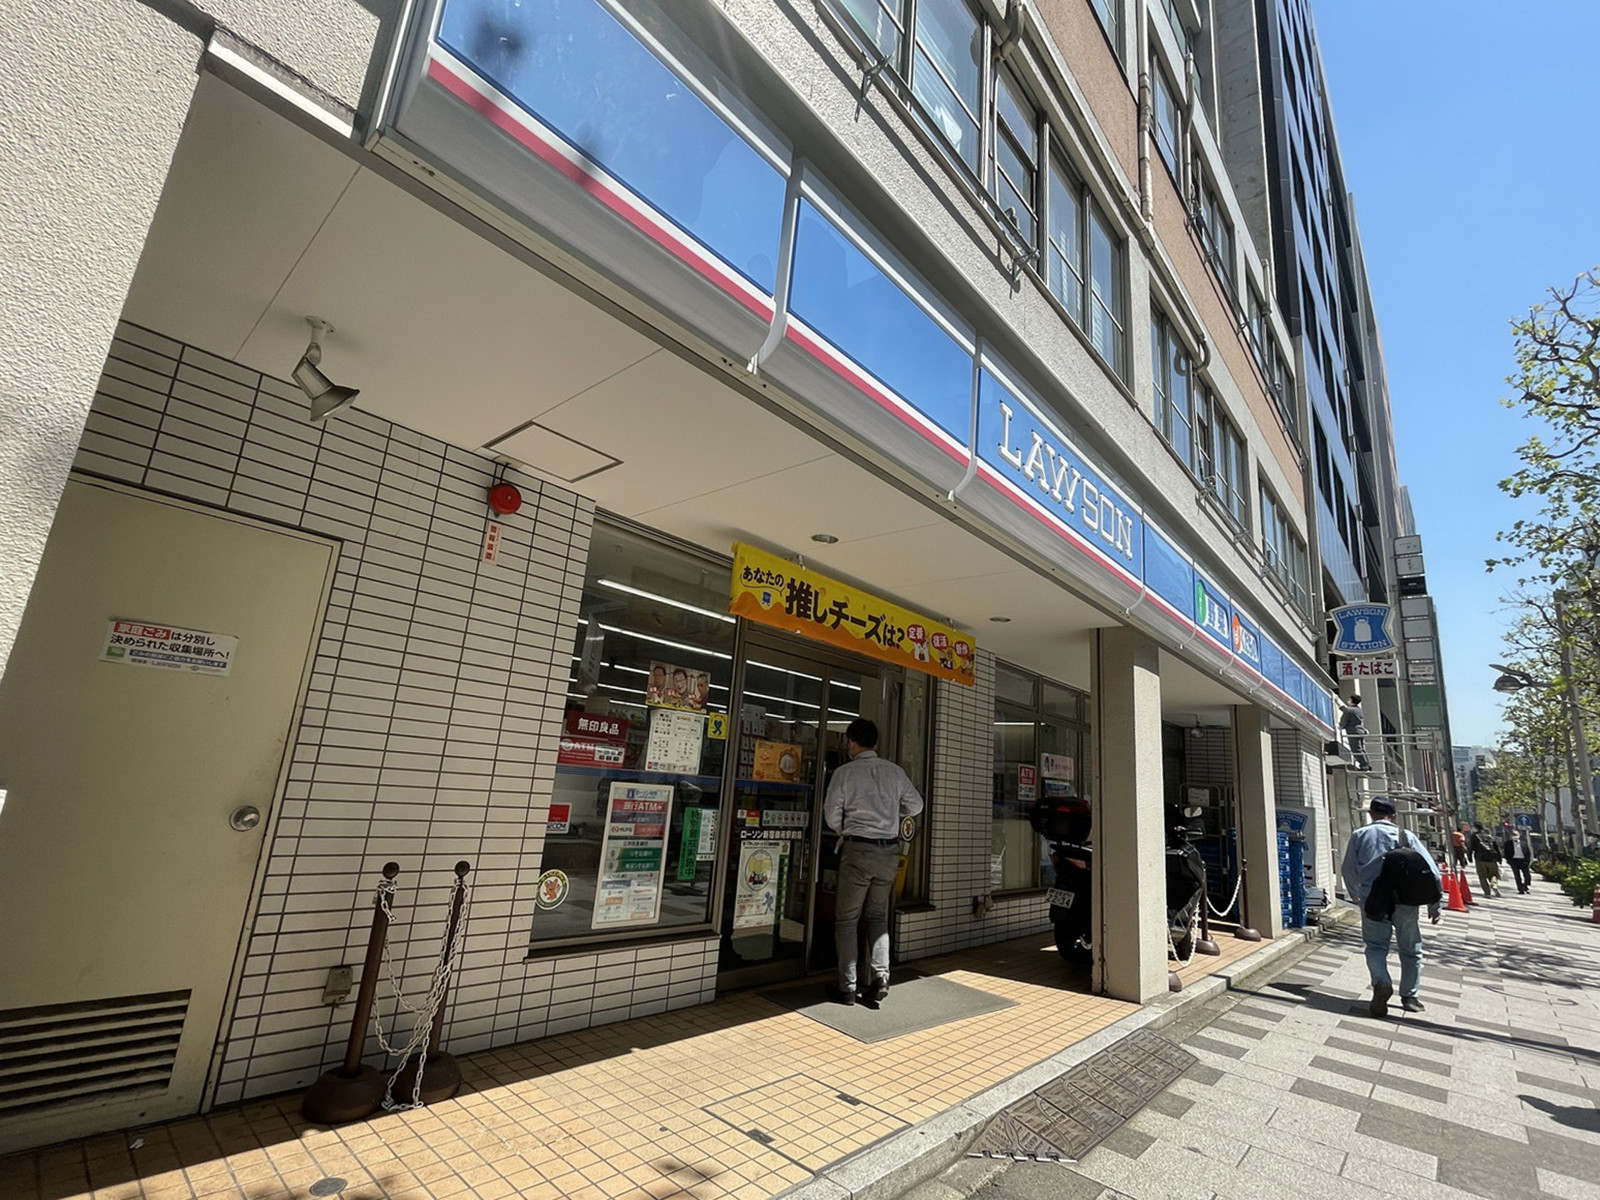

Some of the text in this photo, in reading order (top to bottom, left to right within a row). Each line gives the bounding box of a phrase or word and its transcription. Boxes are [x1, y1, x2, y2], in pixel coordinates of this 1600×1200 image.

[998, 401, 1133, 560] LAWSON
[742, 565, 785, 588] あなたの
[1338, 607, 1386, 619] LAWSON
[908, 626, 926, 640] 定番
[109, 633, 231, 660] 決められた収集場所へ!
[1340, 639, 1388, 650] STATION
[1342, 662, 1394, 676] 酒・たばこ
[577, 717, 619, 735] 無印良品
